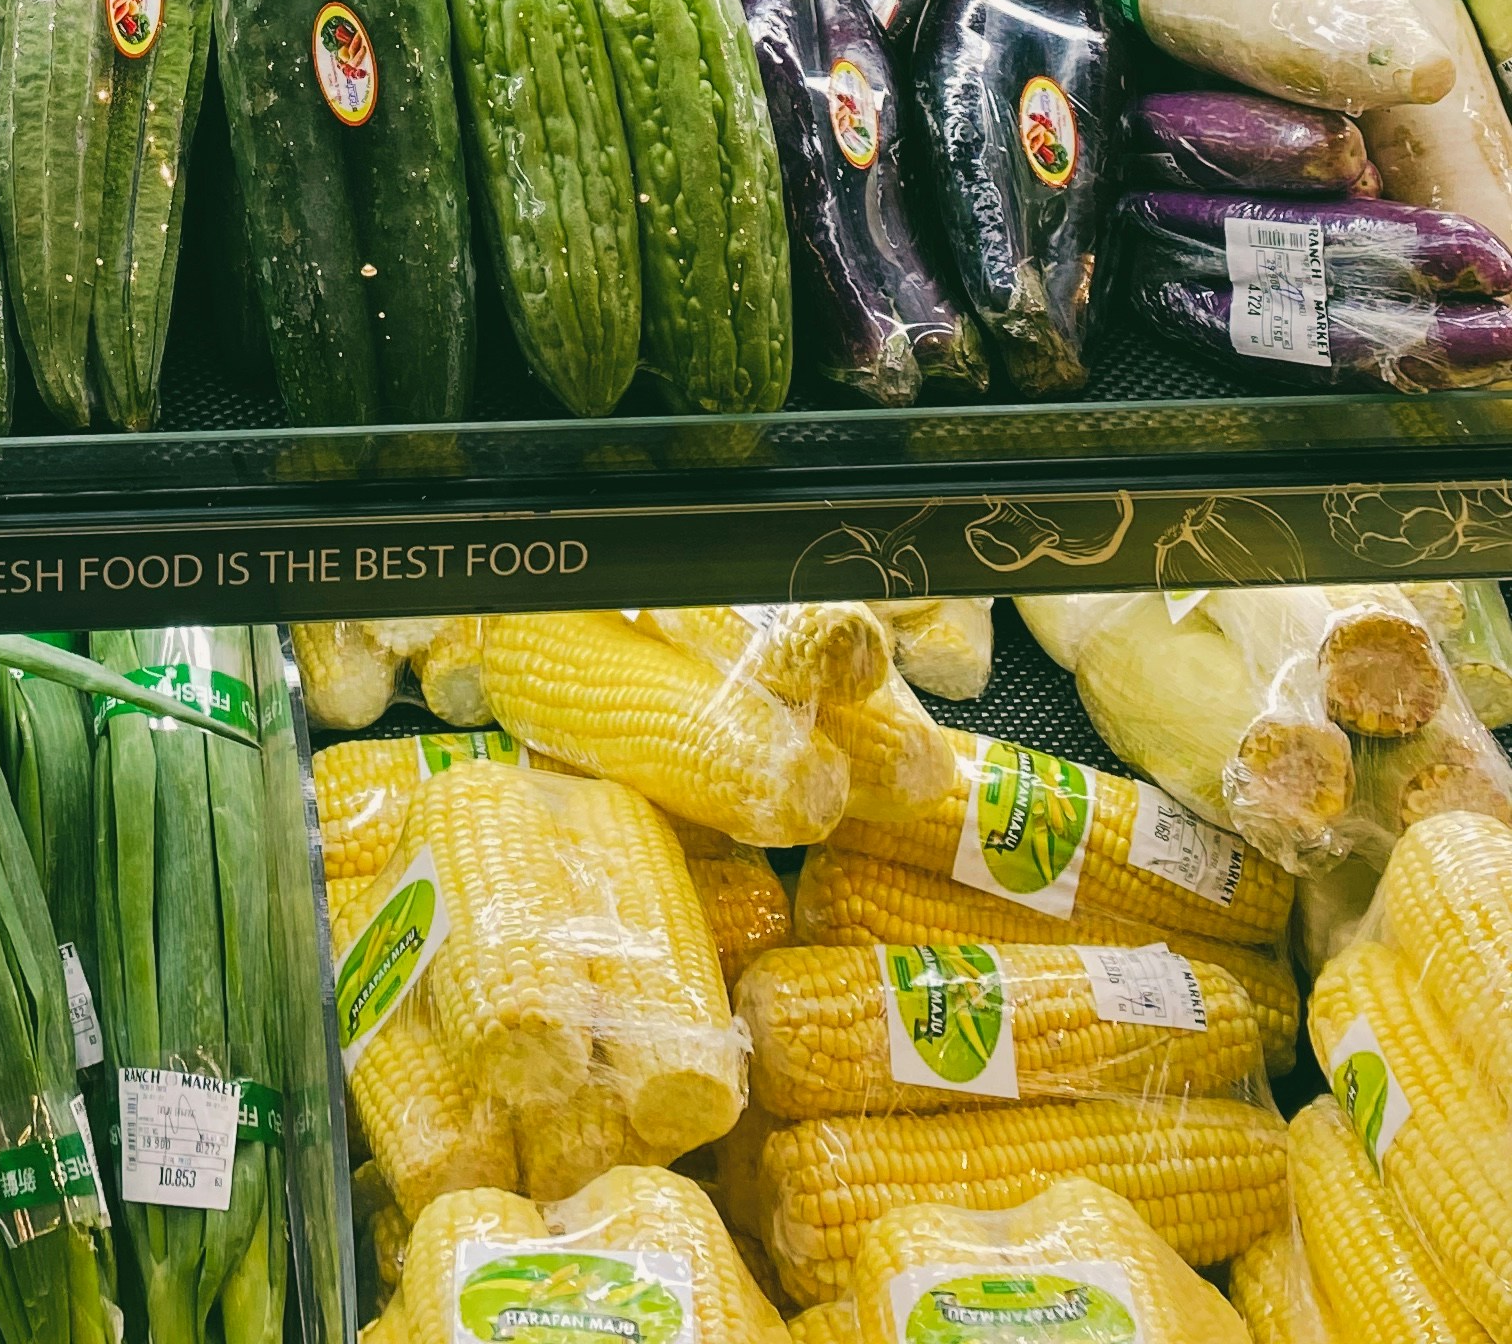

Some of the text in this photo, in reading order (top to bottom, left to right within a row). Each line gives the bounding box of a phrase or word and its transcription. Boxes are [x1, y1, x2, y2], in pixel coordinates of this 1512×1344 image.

[1248, 283, 1262, 316] 4.724
[1308, 228, 1331, 358] RANCH MARKET
[80, 554, 203, 593] FOOD
[217, 551, 250, 587] IS
[259, 548, 340, 584] THE
[355, 545, 455, 582] BEST
[465, 540, 588, 578] FOOD
[1005, 807, 1026, 849] MAJU
[351, 928, 415, 1018] HARAPAN MAJU
[930, 989, 943, 1034] MAJU
[124, 1068, 238, 1097] RANCH MARKET
[158, 1166, 197, 1188] 10.853
[506, 1311, 635, 1336] HARAPAN MAJU
